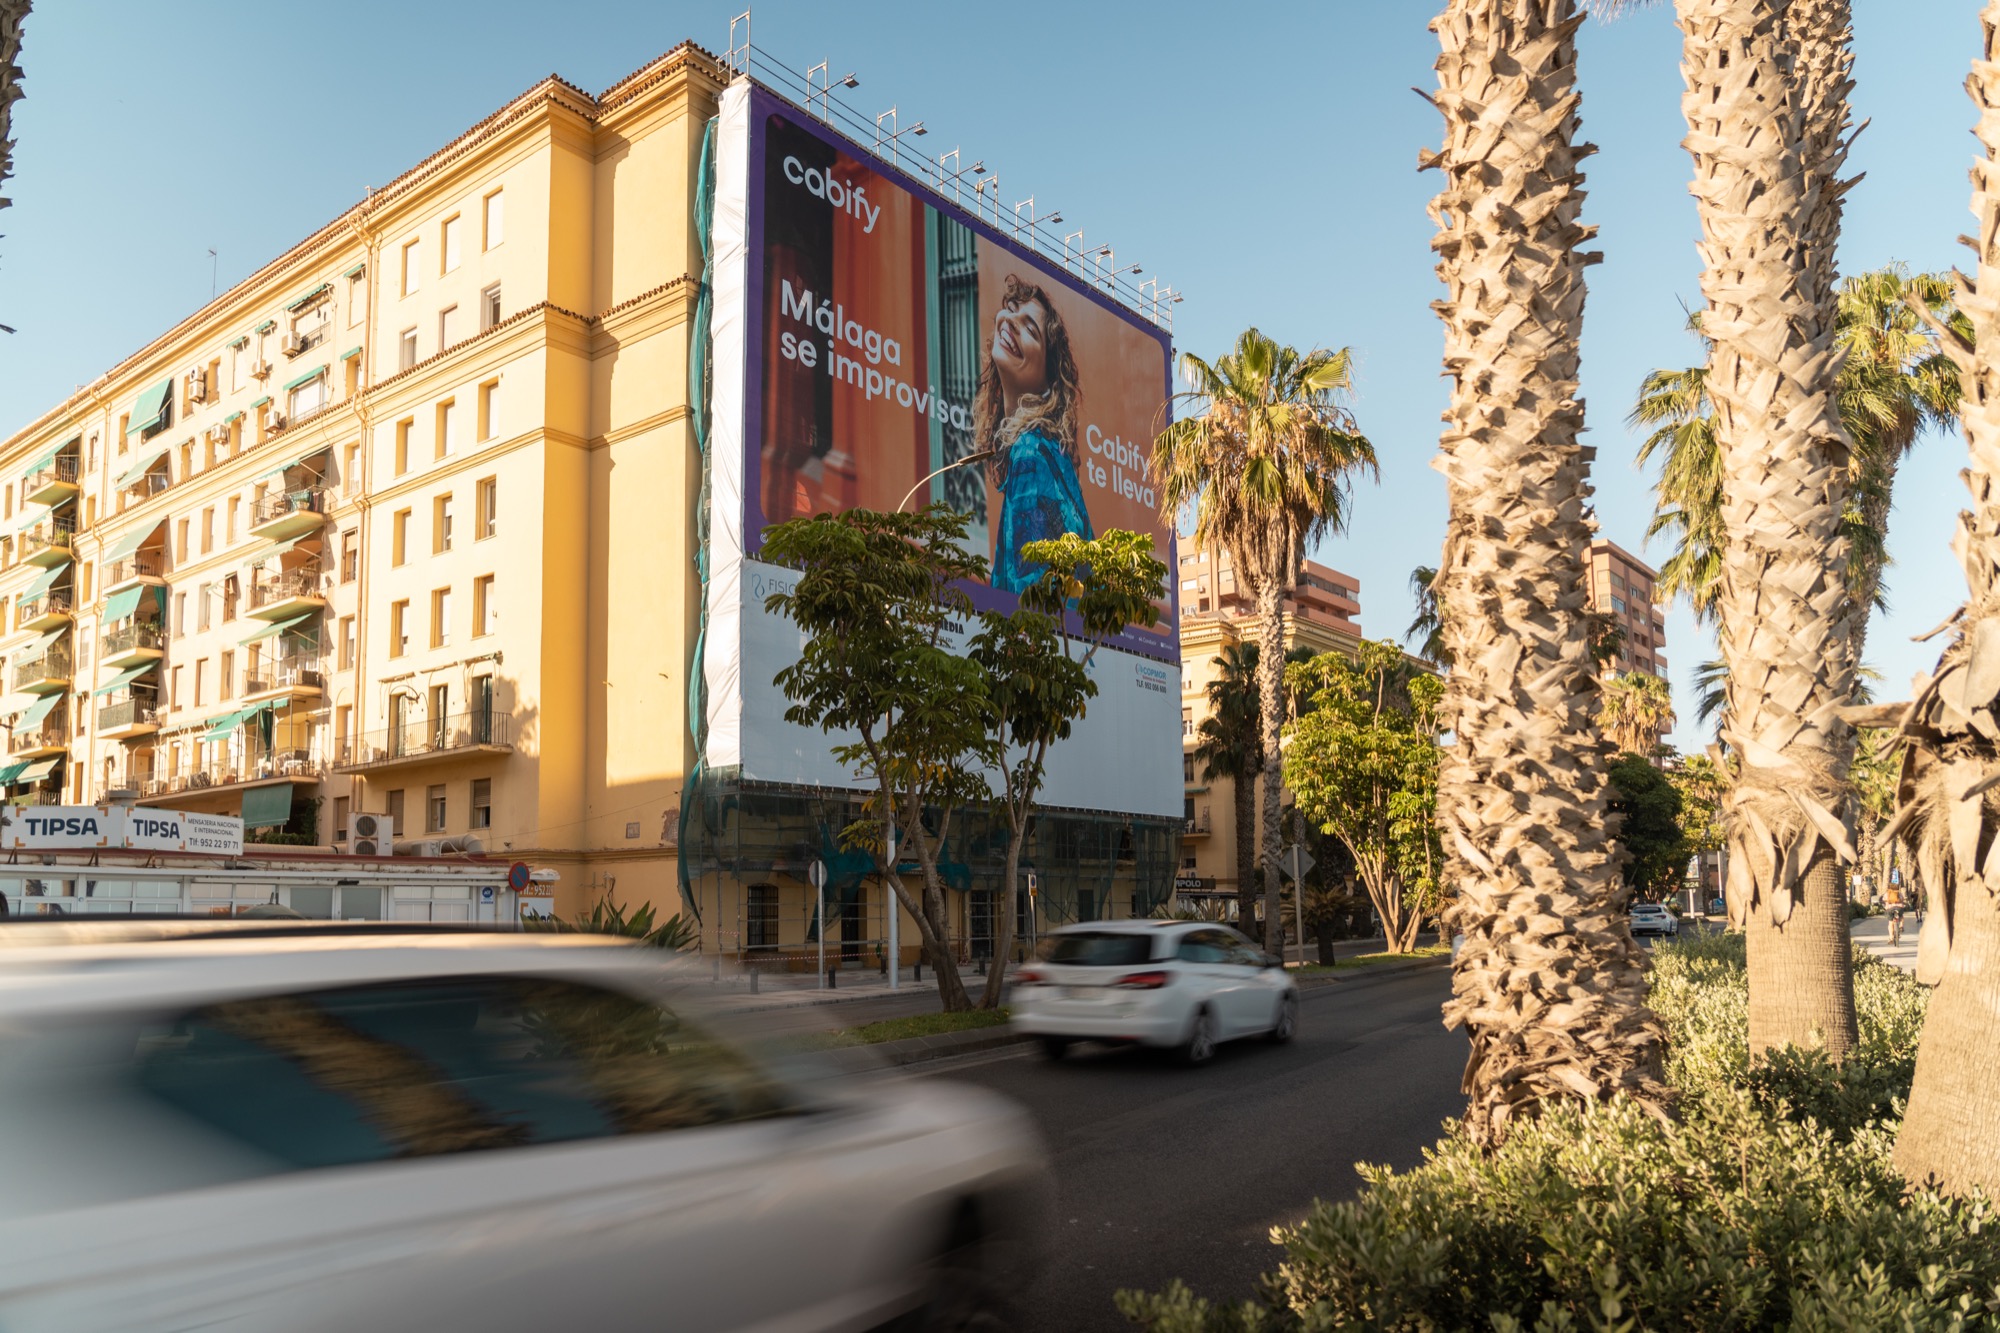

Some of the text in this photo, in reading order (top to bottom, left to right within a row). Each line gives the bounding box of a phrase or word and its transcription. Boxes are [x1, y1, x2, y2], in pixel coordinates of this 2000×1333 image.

[783, 155, 881, 234] cabify
[781, 279, 901, 366] Málaga
[781, 331, 967, 431] se improvisa
[1086, 424, 1151, 482] Cabify
[1086, 457, 1155, 510] te lleva
[24, 817, 99, 836] TIPSA
[133, 818, 181, 839] TIPSA
[187, 818, 240, 829] MENSAJERIA NACIONAL
[197, 827, 234, 836] INTERNACIONAL
[200, 838, 213, 847] 952
[213, 839, 222, 848] 22
[223, 840, 232, 849] 97
[232, 841, 239, 850] 71
[1176, 879, 1202, 888] APOLO
